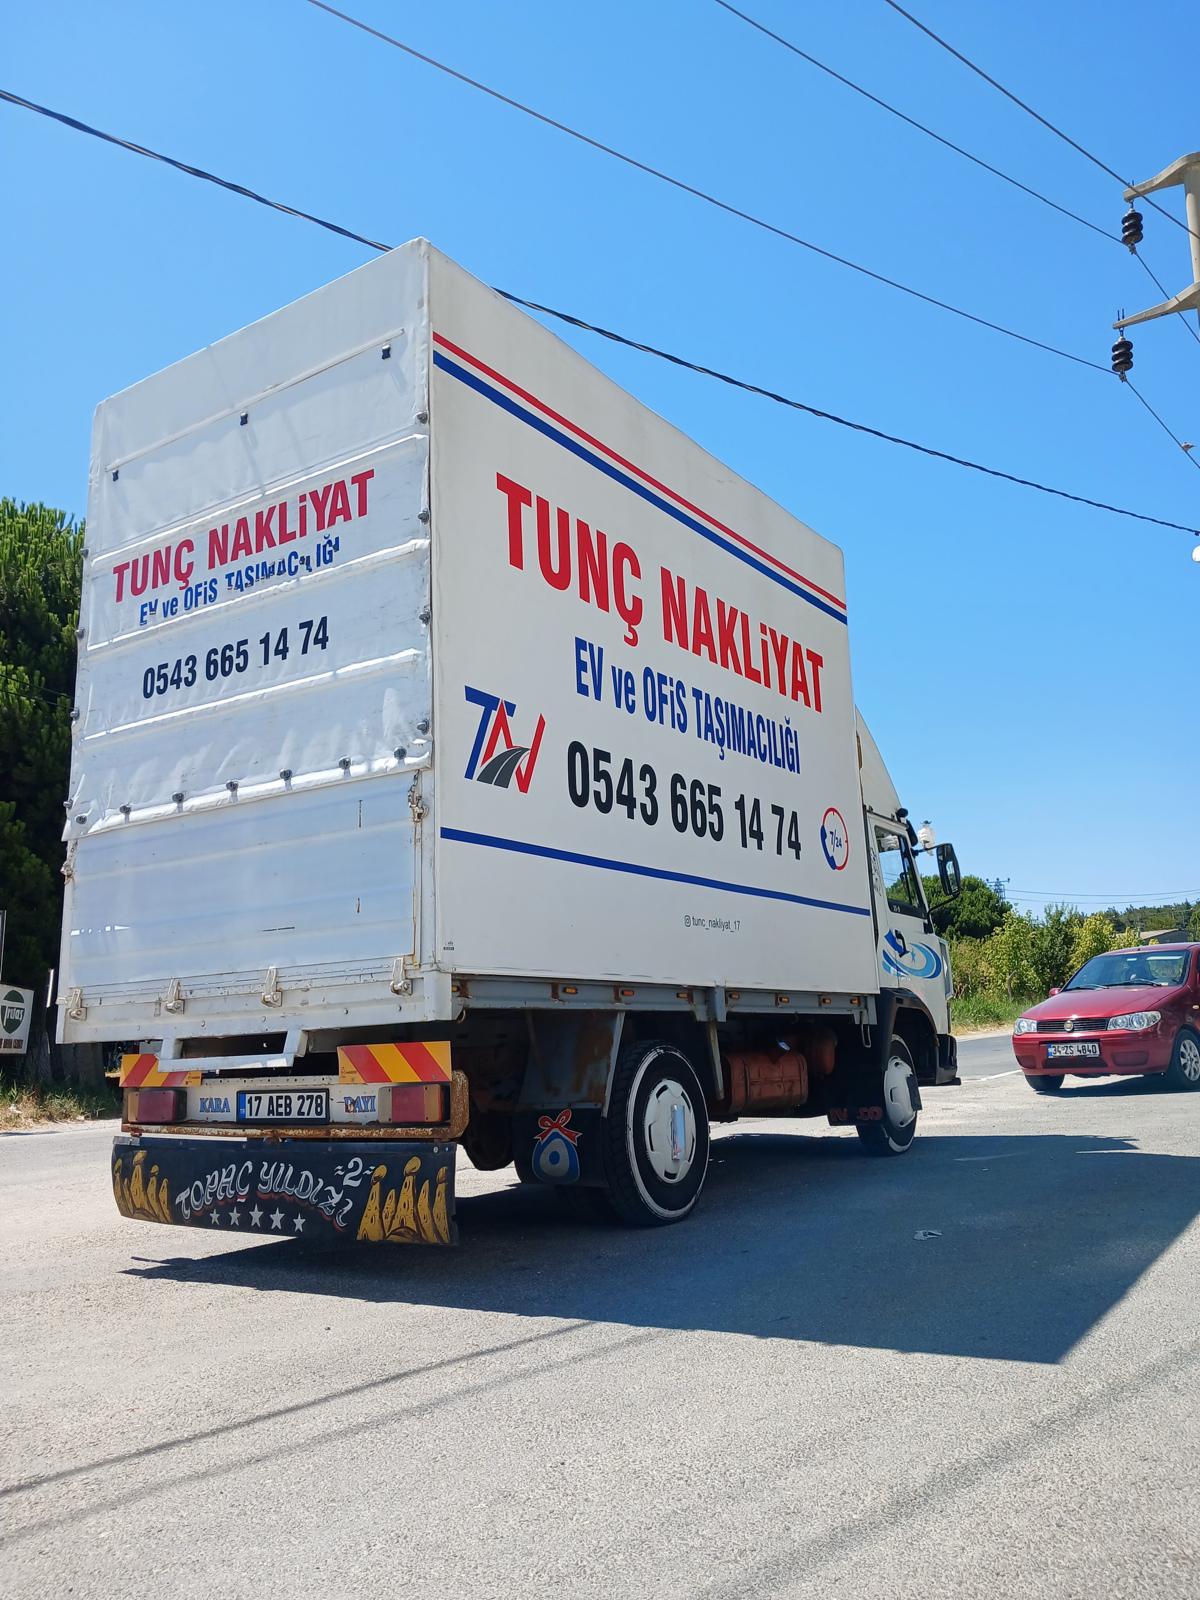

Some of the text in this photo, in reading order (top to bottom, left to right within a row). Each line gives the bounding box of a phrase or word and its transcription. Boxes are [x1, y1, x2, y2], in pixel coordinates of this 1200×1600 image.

[113, 540, 195, 602] TUNÇ
[496, 473, 644, 648] TUNÇ
[162, 596, 179, 619] ve
[142, 616, 329, 699] 0543 665 14 74
[576, 636, 604, 702] EV
[611, 666, 636, 718] ve
[692, 687, 801, 774] TAŞIMACILIĞI
[567, 740, 802, 861] 0543 665 14 74
[829, 829, 844, 854] 7/24
[1052, 1045, 1062, 1055] 34
[199, 1097, 231, 1113] KARA
[247, 1094, 324, 1117] 17 AEB 278
[343, 1095, 377, 1113] DAYI
[175, 1160, 254, 1220] TOPAÇ
